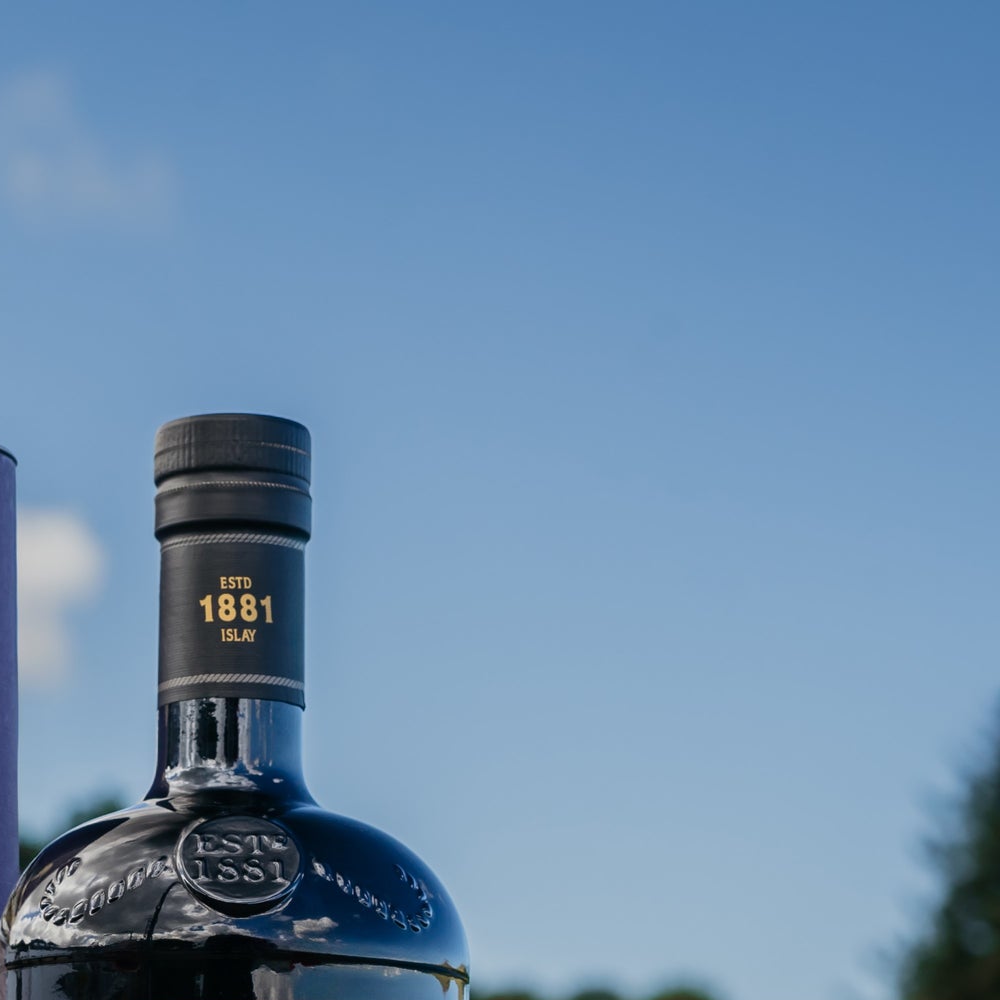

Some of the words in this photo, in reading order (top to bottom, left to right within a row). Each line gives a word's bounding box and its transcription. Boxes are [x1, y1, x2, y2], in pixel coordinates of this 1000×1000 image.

[219, 576, 252, 589] ESTD
[199, 593, 273, 623] 1881
[221, 628, 256, 642] ISLAY
[194, 859, 287, 882] 1881
